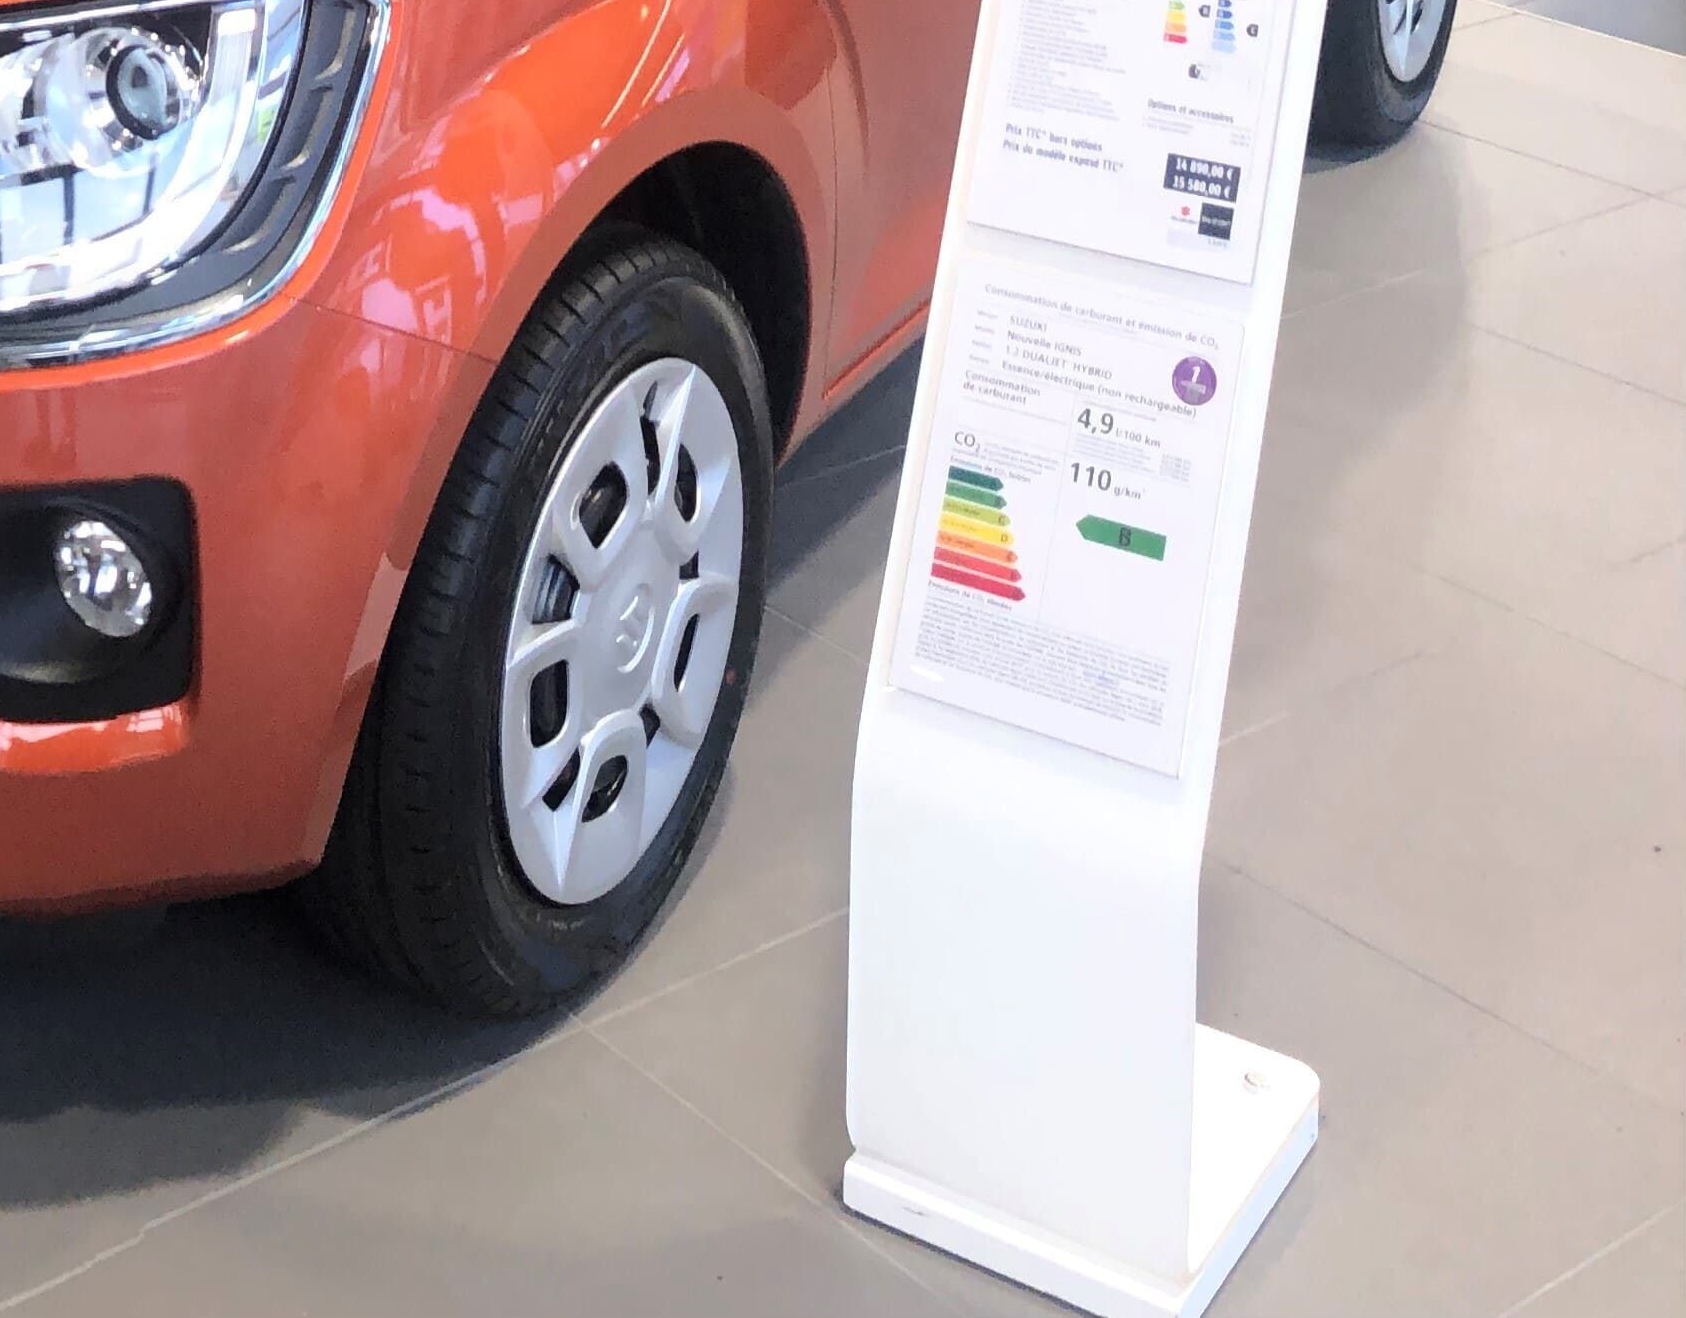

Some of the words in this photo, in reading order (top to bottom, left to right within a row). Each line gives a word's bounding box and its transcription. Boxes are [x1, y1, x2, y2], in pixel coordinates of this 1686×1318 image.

[1002, 139, 1020, 153] Prix
[1005, 122, 1023, 137] Prix
[1070, 136, 1103, 152] options
[1175, 157, 1188, 172] 14
[1172, 175, 1186, 189] 15
[984, 283, 1059, 310] Consommation
[1059, 301, 1073, 314] de
[1074, 304, 1123, 327] carburant
[1125, 317, 1137, 329] et
[1138, 319, 1183, 340] émission
[1184, 331, 1198, 343] de
[1009, 315, 1048, 333] SUZUKI
[1007, 330, 1052, 351] Nouvelle
[1054, 341, 1083, 357] IGNIS
[1021, 348, 1067, 369] DUALJET
[1072, 361, 1113, 381] HYBRID
[962, 380, 975, 393] de
[977, 384, 1027, 406] carburant
[964, 369, 1041, 397] Consommation
[1097, 382, 1122, 399] (non
[1124, 390, 1197, 419] rechargeable)
[1076, 406, 1115, 437] 4,9
[1144, 433, 1161, 449] km
[1070, 462, 1112, 493] 110
[1117, 526, 1133, 548] B
